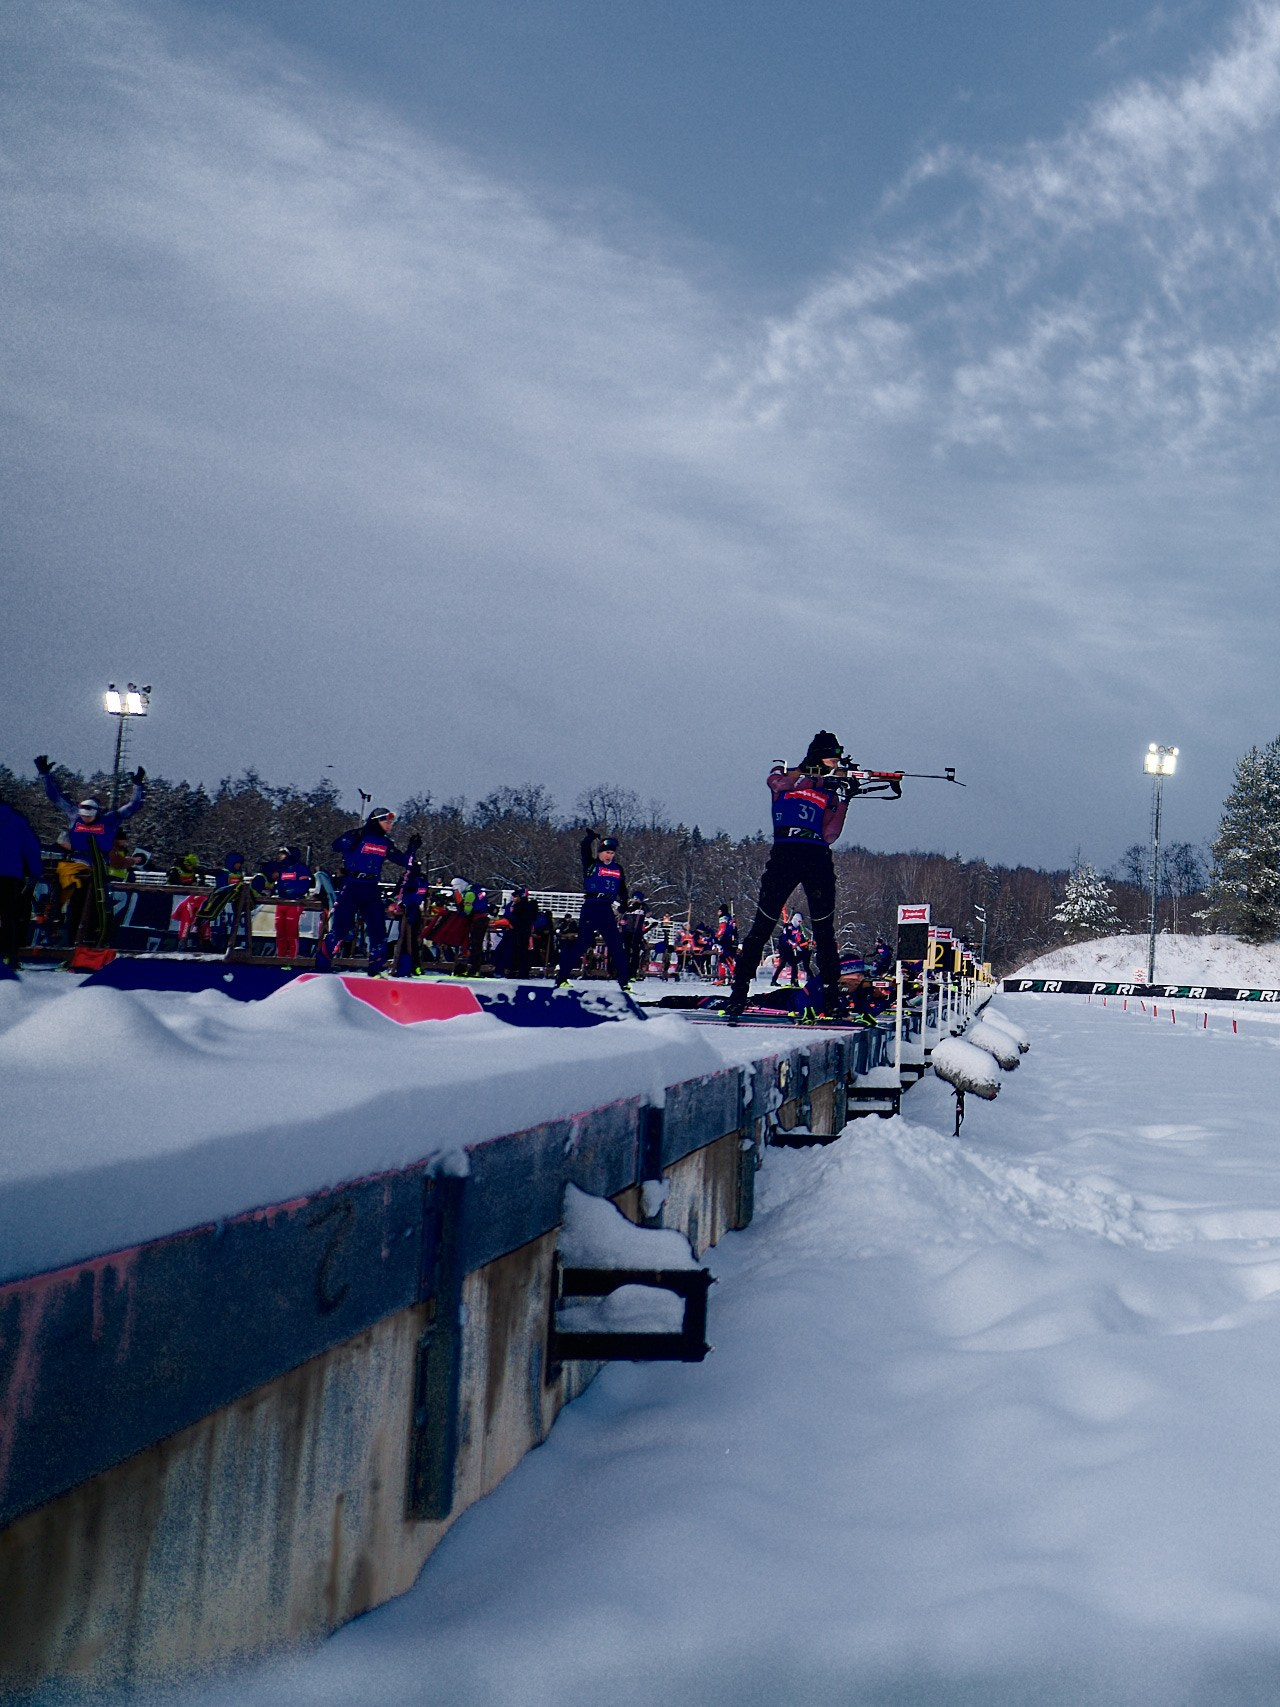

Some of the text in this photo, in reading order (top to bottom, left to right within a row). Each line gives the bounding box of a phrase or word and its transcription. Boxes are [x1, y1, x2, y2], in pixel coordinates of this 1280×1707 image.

[798, 804, 816, 822] 37
[934, 945, 944, 967] 2
[1018, 980, 1062, 992] PARI
[1092, 983, 1135, 995] PARI
[1164, 986, 1207, 999] PARI
[1235, 989, 1279, 1002] PARI
